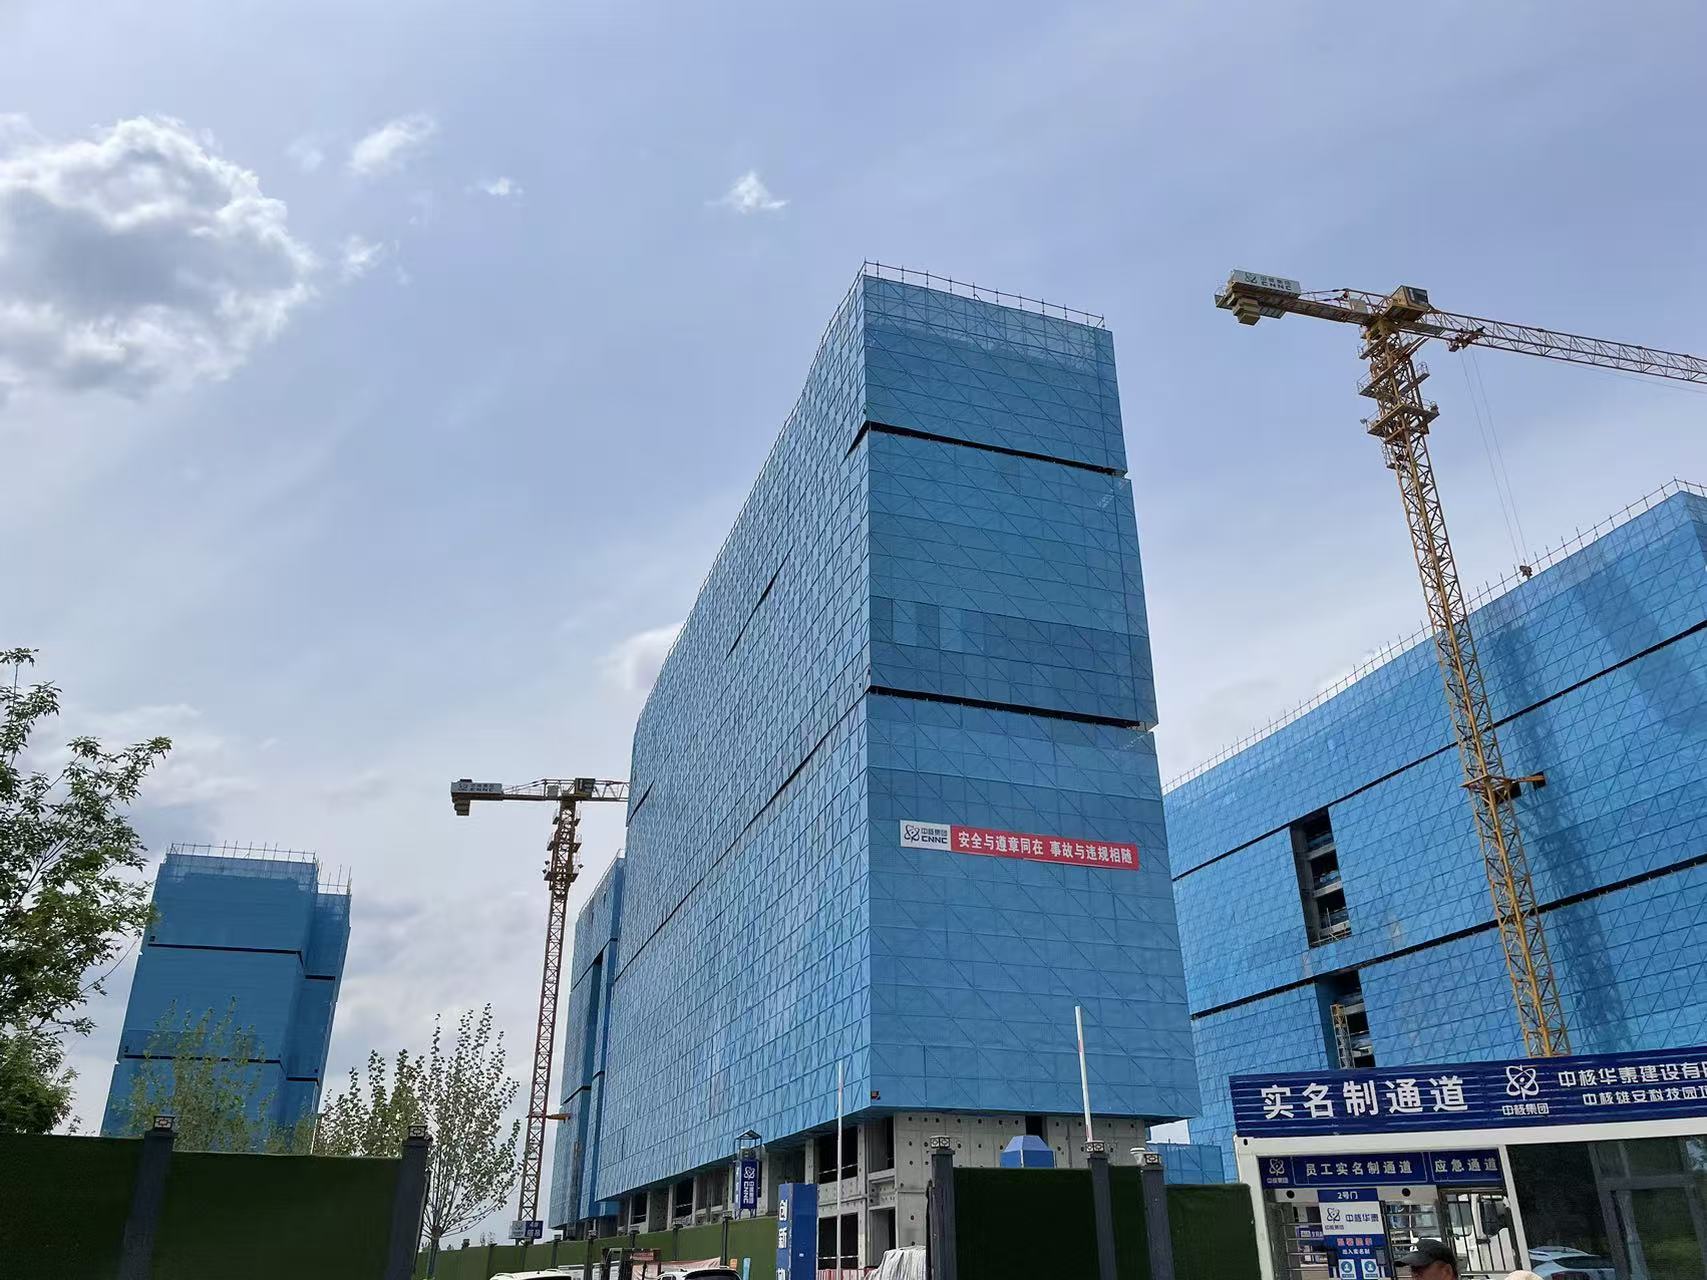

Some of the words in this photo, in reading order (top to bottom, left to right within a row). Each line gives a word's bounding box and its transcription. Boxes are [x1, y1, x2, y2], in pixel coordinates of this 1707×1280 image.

[921, 835, 948, 845] CNNC
[1049, 840, 1133, 864] 事故与违规相随
[1261, 1075, 1468, 1120] 实名制通道
[1502, 1102, 1549, 1116] 中核集团
[1306, 1160, 1413, 1177] 员工实名制通道
[1434, 1157, 1498, 1173] 应急通道
[1337, 1191, 1358, 1200] 2号门
